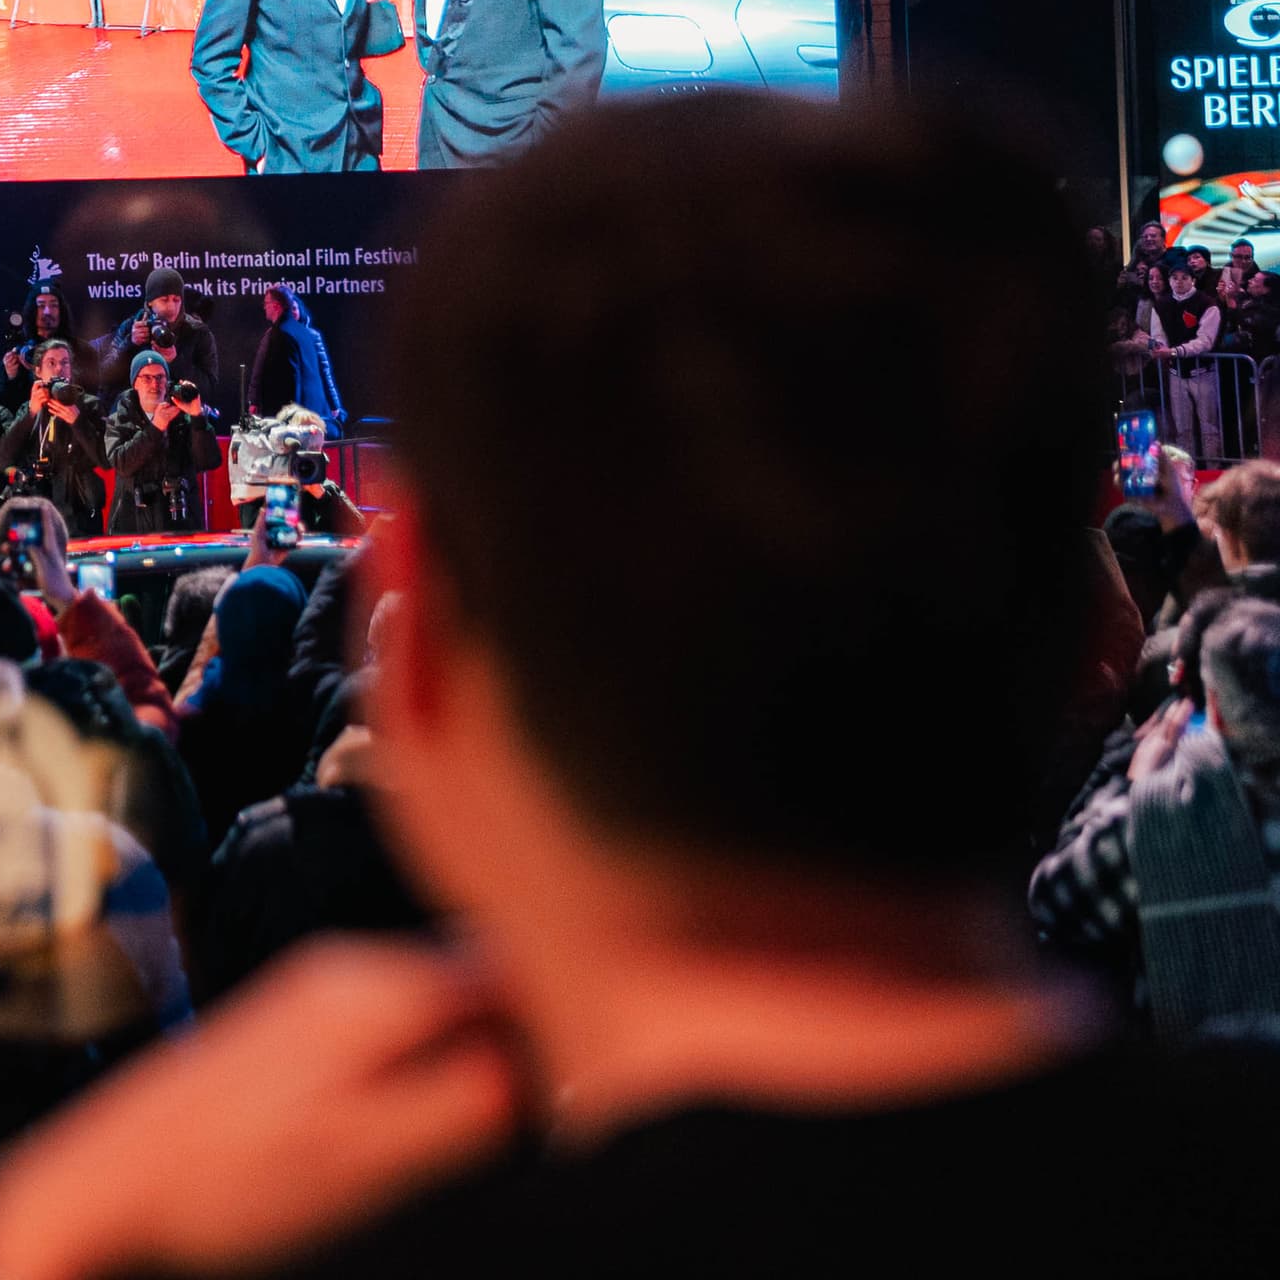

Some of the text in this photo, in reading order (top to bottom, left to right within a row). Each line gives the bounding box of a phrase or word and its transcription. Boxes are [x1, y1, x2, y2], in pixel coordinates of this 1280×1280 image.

[1204, 93, 1280, 127] BER
[86, 253, 116, 271] The
[153, 251, 201, 271] Berlin
[205, 247, 311, 269] International
[315, 248, 350, 267] Film
[355, 247, 417, 266] Festival
[88, 280, 142, 299] wishes
[217, 278, 237, 296] its
[315, 276, 385, 295] Partners
